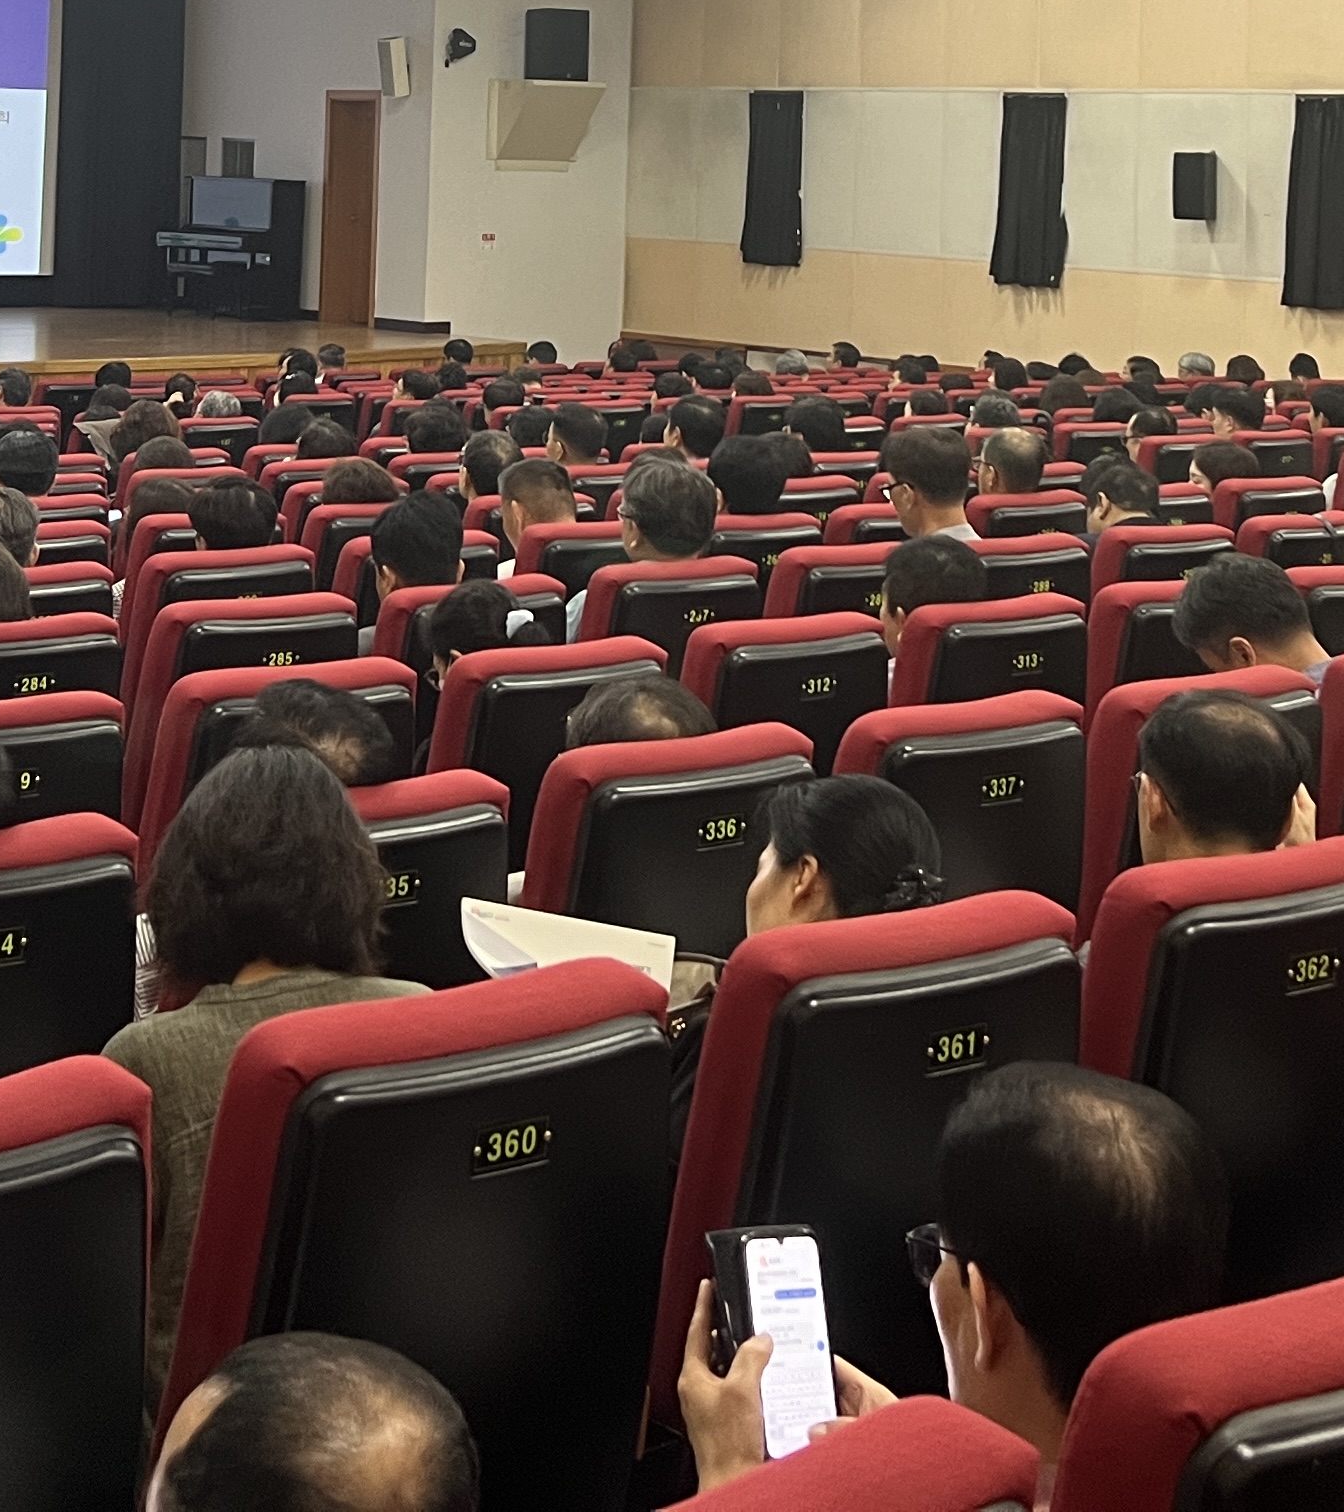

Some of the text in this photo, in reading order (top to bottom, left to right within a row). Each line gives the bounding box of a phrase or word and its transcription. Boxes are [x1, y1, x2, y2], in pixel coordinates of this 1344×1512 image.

[268, 651, 293, 666] 285
[1016, 653, 1038, 669] 313
[21, 676, 47, 692] 284
[807, 677, 830, 694] 312
[989, 776, 1016, 798] 337
[706, 818, 737, 841] 336
[387, 875, 410, 897] 35
[1296, 954, 1330, 983] 362
[937, 1031, 976, 1063] 361
[486, 1124, 537, 1163] 360
